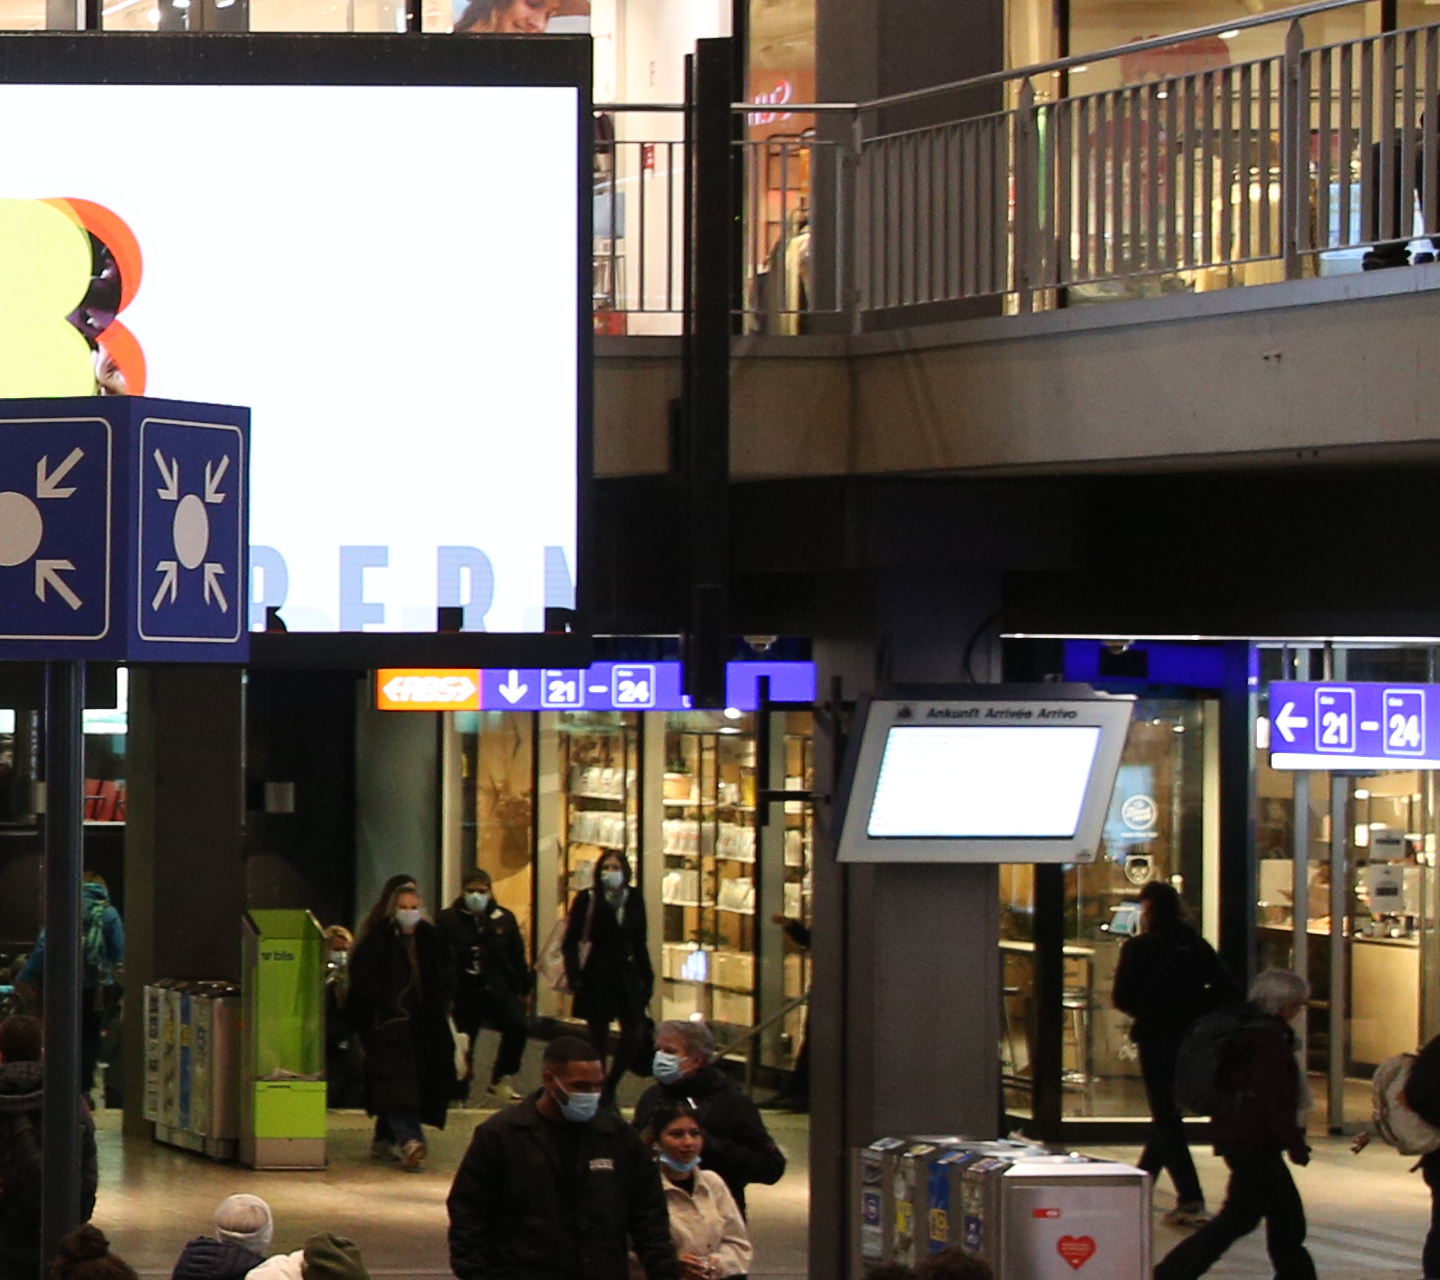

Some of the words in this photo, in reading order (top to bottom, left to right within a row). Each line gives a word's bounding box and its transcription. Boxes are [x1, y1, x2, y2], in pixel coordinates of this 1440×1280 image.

[548, 680, 576, 702] 21
[617, 680, 649, 702] 24
[926, 706, 981, 720] Ankunft
[984, 706, 1033, 720] Arrivée
[1037, 706, 1078, 720] Arrivo
[1321, 712, 1350, 745] 21
[1389, 714, 1421, 748] 24
